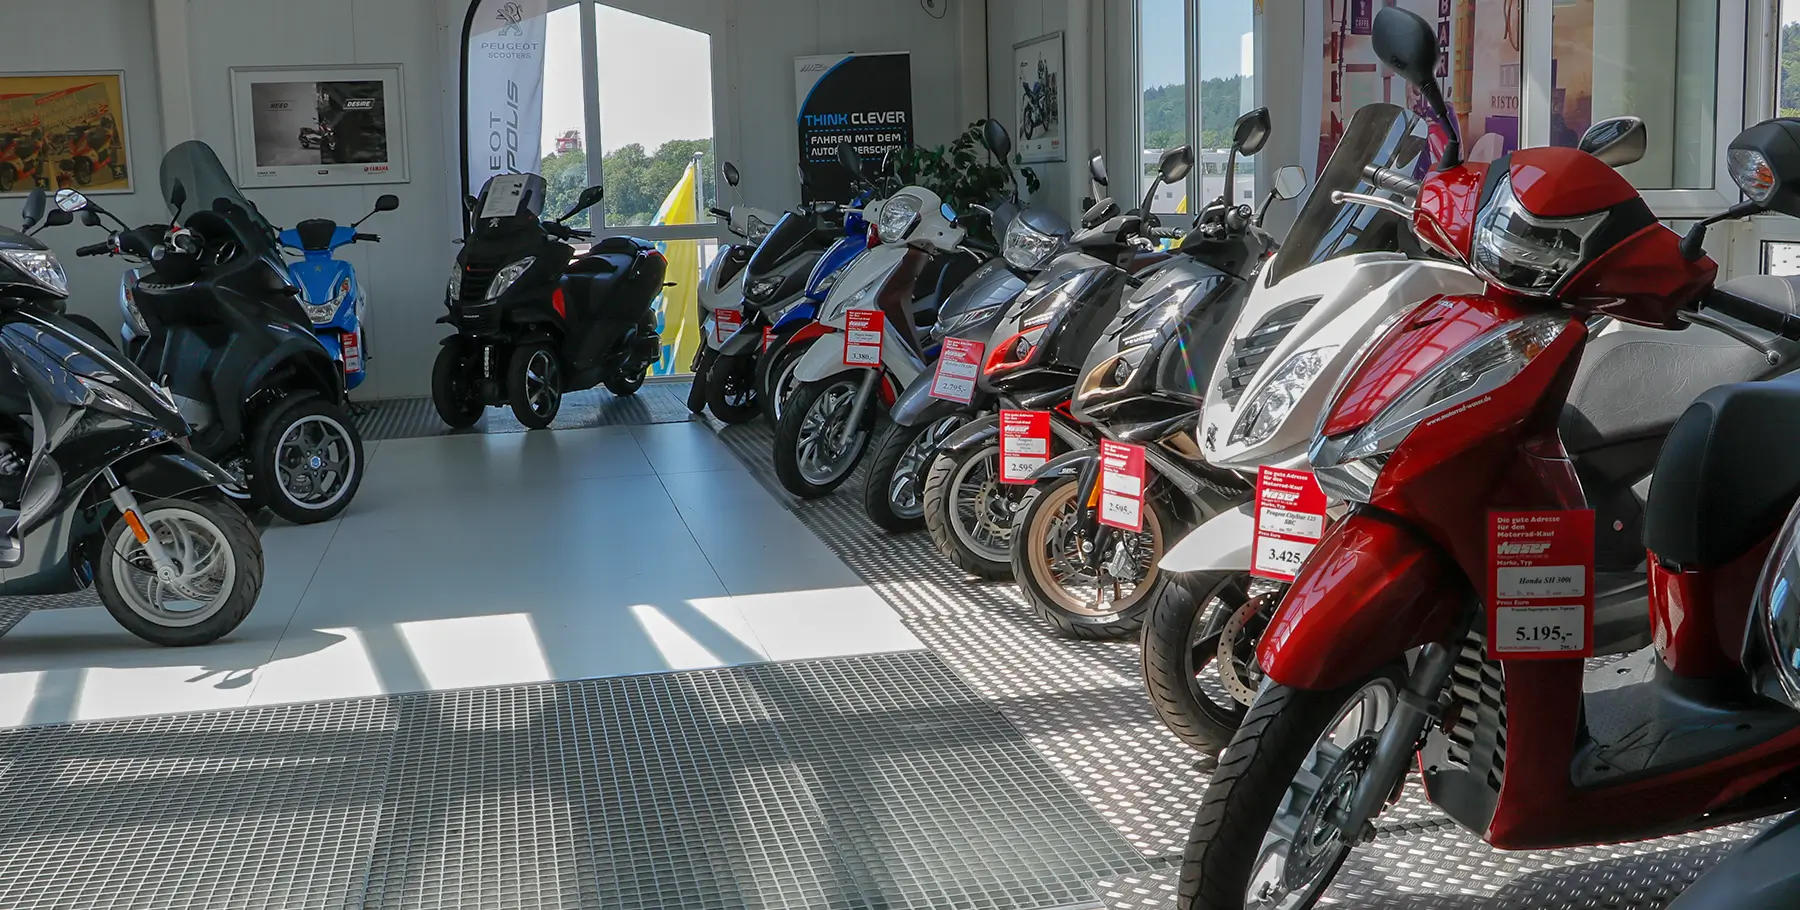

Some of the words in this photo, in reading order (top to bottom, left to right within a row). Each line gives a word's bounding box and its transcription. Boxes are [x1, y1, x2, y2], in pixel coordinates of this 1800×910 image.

[481, 42, 539, 50] PEUGEOT
[347, 100, 371, 108] DESIRE
[805, 114, 848, 126] THINK
[851, 111, 907, 125] CLEVER
[811, 136, 853, 145] FAHREN
[855, 134, 874, 144] MIT
[877, 133, 902, 143] DEM
[942, 382, 967, 394] 2.795,-
[1287, 473, 1308, 481] Adresse
[1262, 480, 1303, 491] Motorrad-Kauf
[1266, 509, 1286, 518] Peugeot
[1512, 517, 1530, 525] gute
[1519, 577, 1543, 585] Honda
[1556, 576, 1572, 584] 300i
[1516, 625, 1573, 643] 5.195,-
